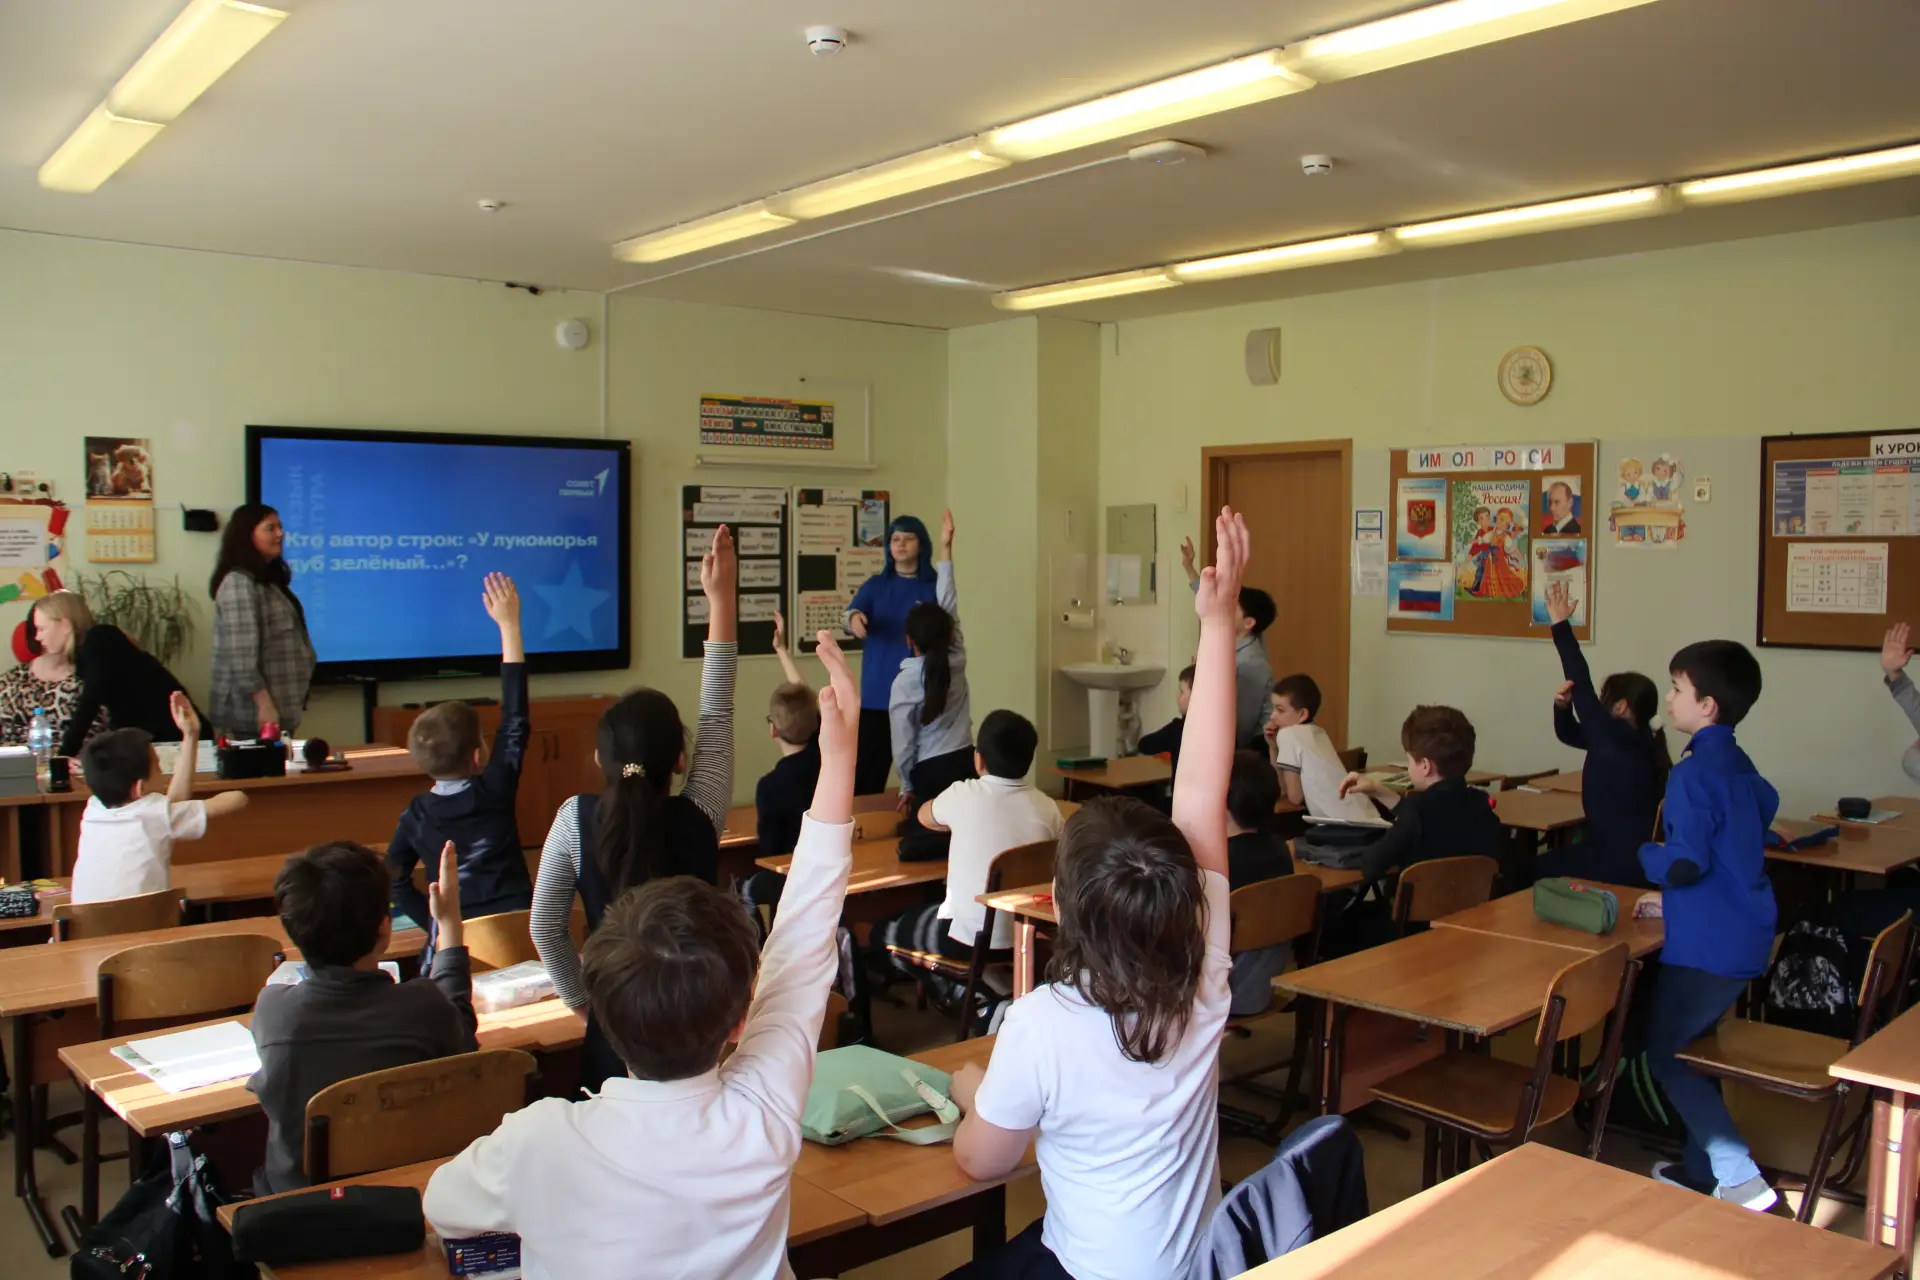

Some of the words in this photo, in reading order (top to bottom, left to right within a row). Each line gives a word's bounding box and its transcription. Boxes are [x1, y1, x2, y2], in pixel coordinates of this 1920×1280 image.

[1876, 444, 1884, 455] К
[1472, 483, 1494, 492] НАША
[1495, 483, 1525, 492] РОДИНА
[1481, 492, 1522, 504] Россия!
[285, 531, 324, 548] Кто
[328, 534, 394, 550] автор
[397, 534, 464, 550] строк:
[492, 534, 598, 550] лукоморья
